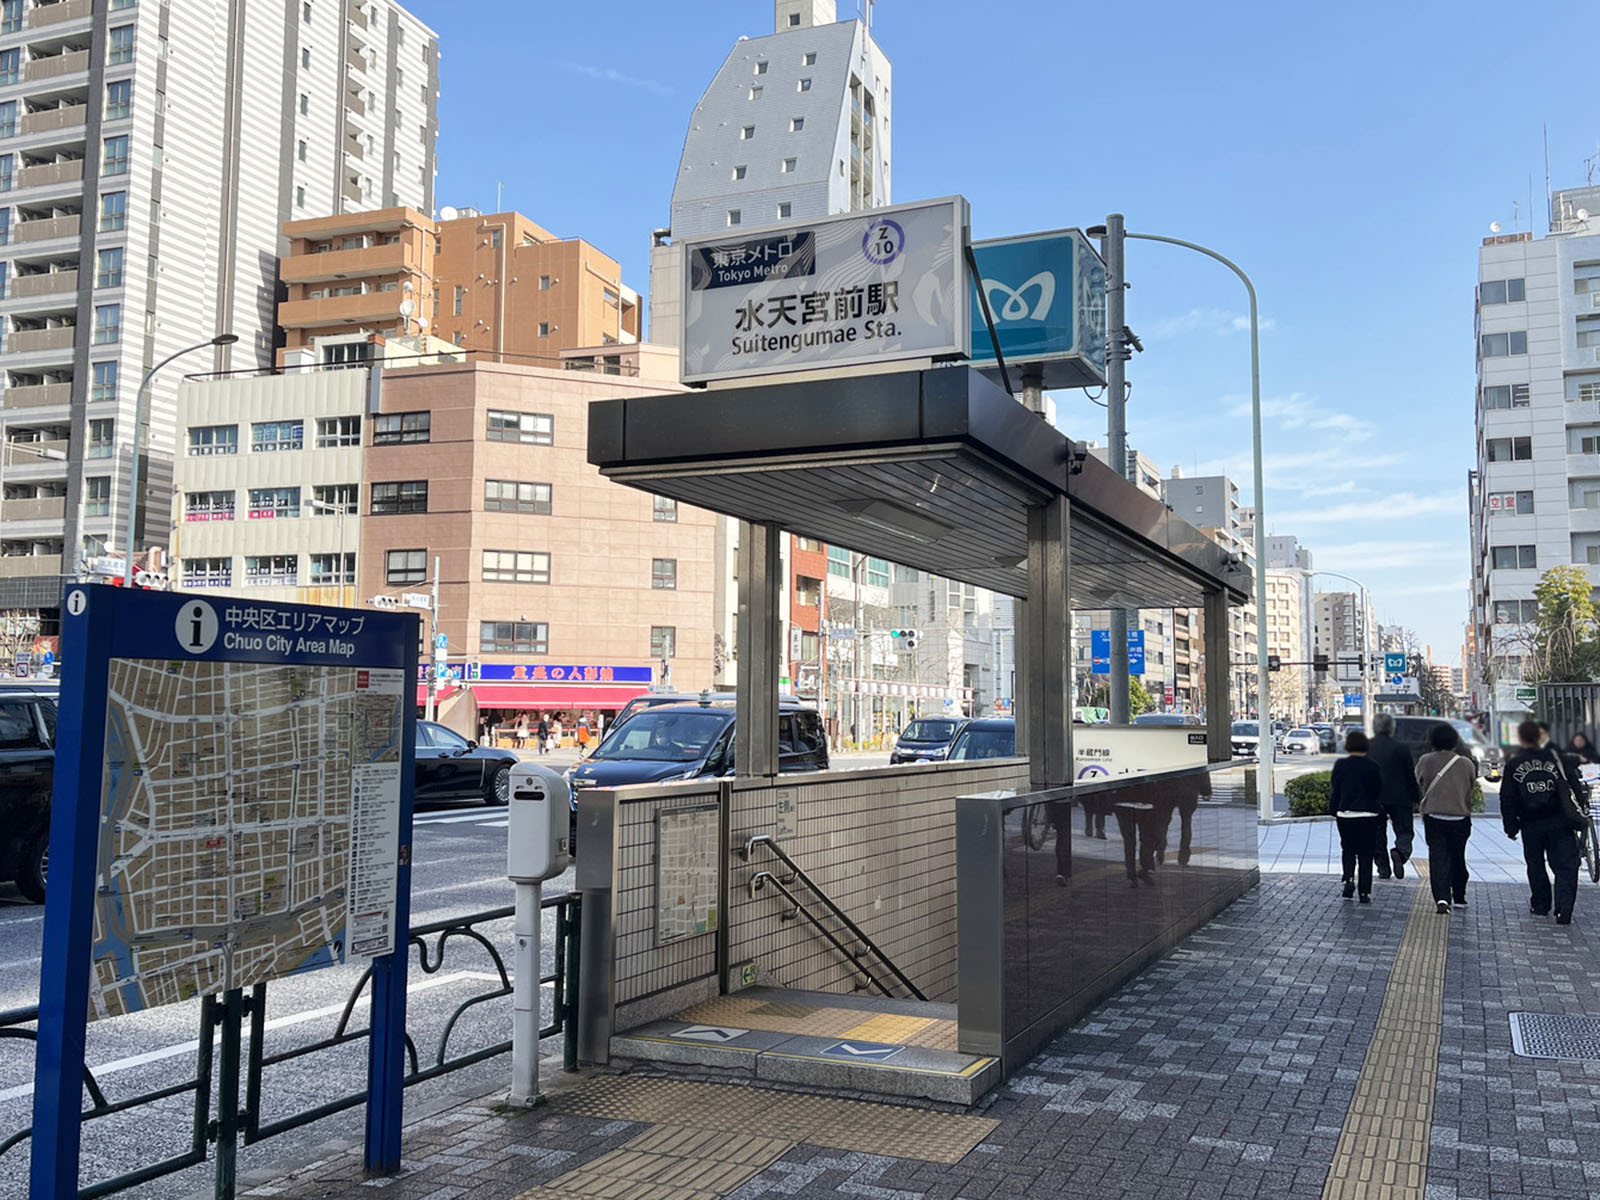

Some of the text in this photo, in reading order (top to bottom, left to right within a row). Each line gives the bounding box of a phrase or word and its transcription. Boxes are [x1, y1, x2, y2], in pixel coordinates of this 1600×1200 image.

[878, 227, 888, 240] Z
[711, 242, 793, 268] 東京メトロ
[875, 241, 894, 255] 10
[718, 264, 788, 283] Tokyo Metro
[735, 281, 899, 332] 水天宮前駅
[732, 319, 902, 356] Suitengumae Sta.
[225, 605, 365, 635] 中央区エリアマップ
[224, 632, 355, 658] Chuo City Area Map
